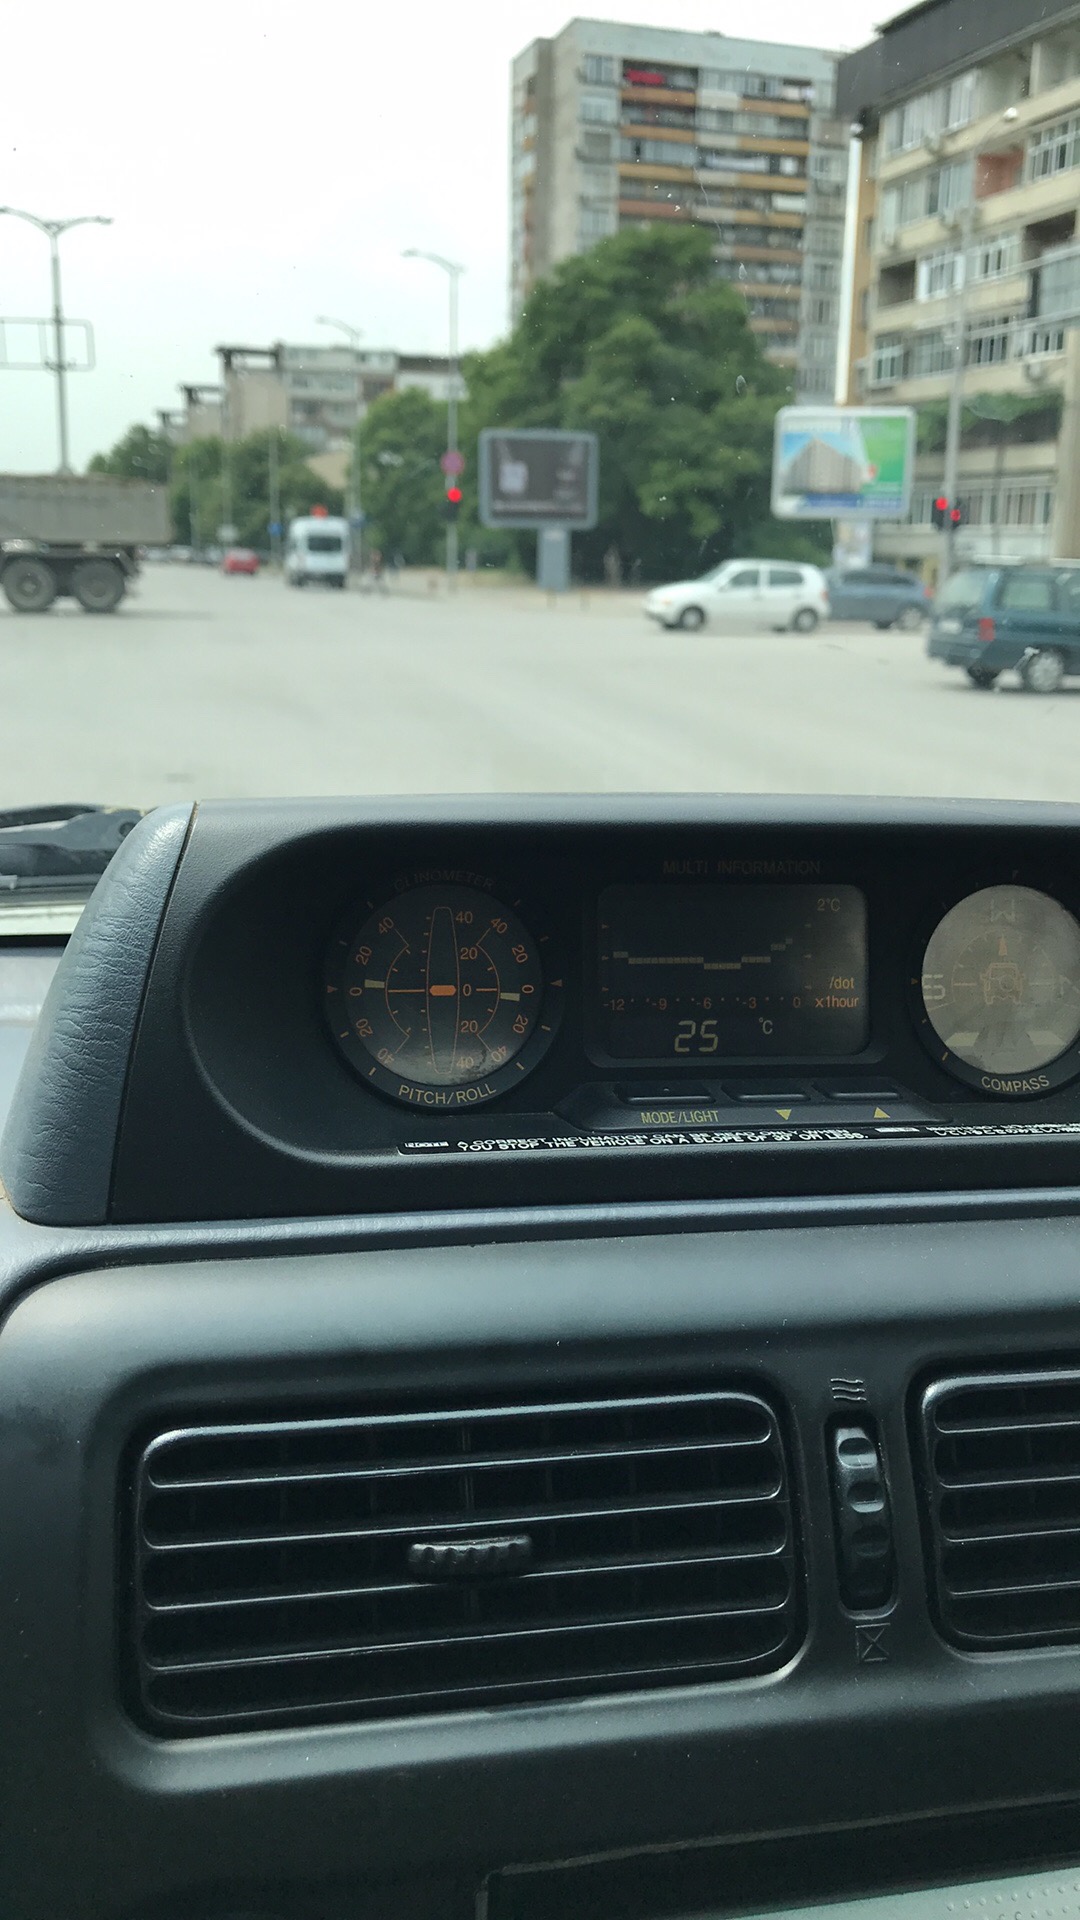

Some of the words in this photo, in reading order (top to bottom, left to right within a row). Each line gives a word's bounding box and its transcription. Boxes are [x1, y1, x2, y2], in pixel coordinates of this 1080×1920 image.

[663, 861, 708, 874] MULTI
[717, 861, 820, 874] INFORMATION
[456, 912, 473, 924] 40
[378, 917, 394, 934] 40
[490, 918, 507, 934] 40
[356, 946, 372, 965] 20
[460, 948, 477, 960] 20
[512, 945, 528, 963] 20
[463, 984, 471, 995] 0
[522, 984, 534, 994] 0
[829, 977, 854, 990] /dot
[350, 987, 362, 996] 0
[815, 994, 858, 1009] x1hour
[356, 1019, 373, 1037] 20
[461, 1021, 478, 1033] 20
[513, 1015, 528, 1034] 20
[674, 1020, 719, 1052] 25
[457, 1057, 473, 1068] 40
[981, 1075, 1049, 1092] COMPASS
[398, 1084, 496, 1104] PITCH/ROLL
[641, 1110, 718, 1124] MODE/LIGHT
